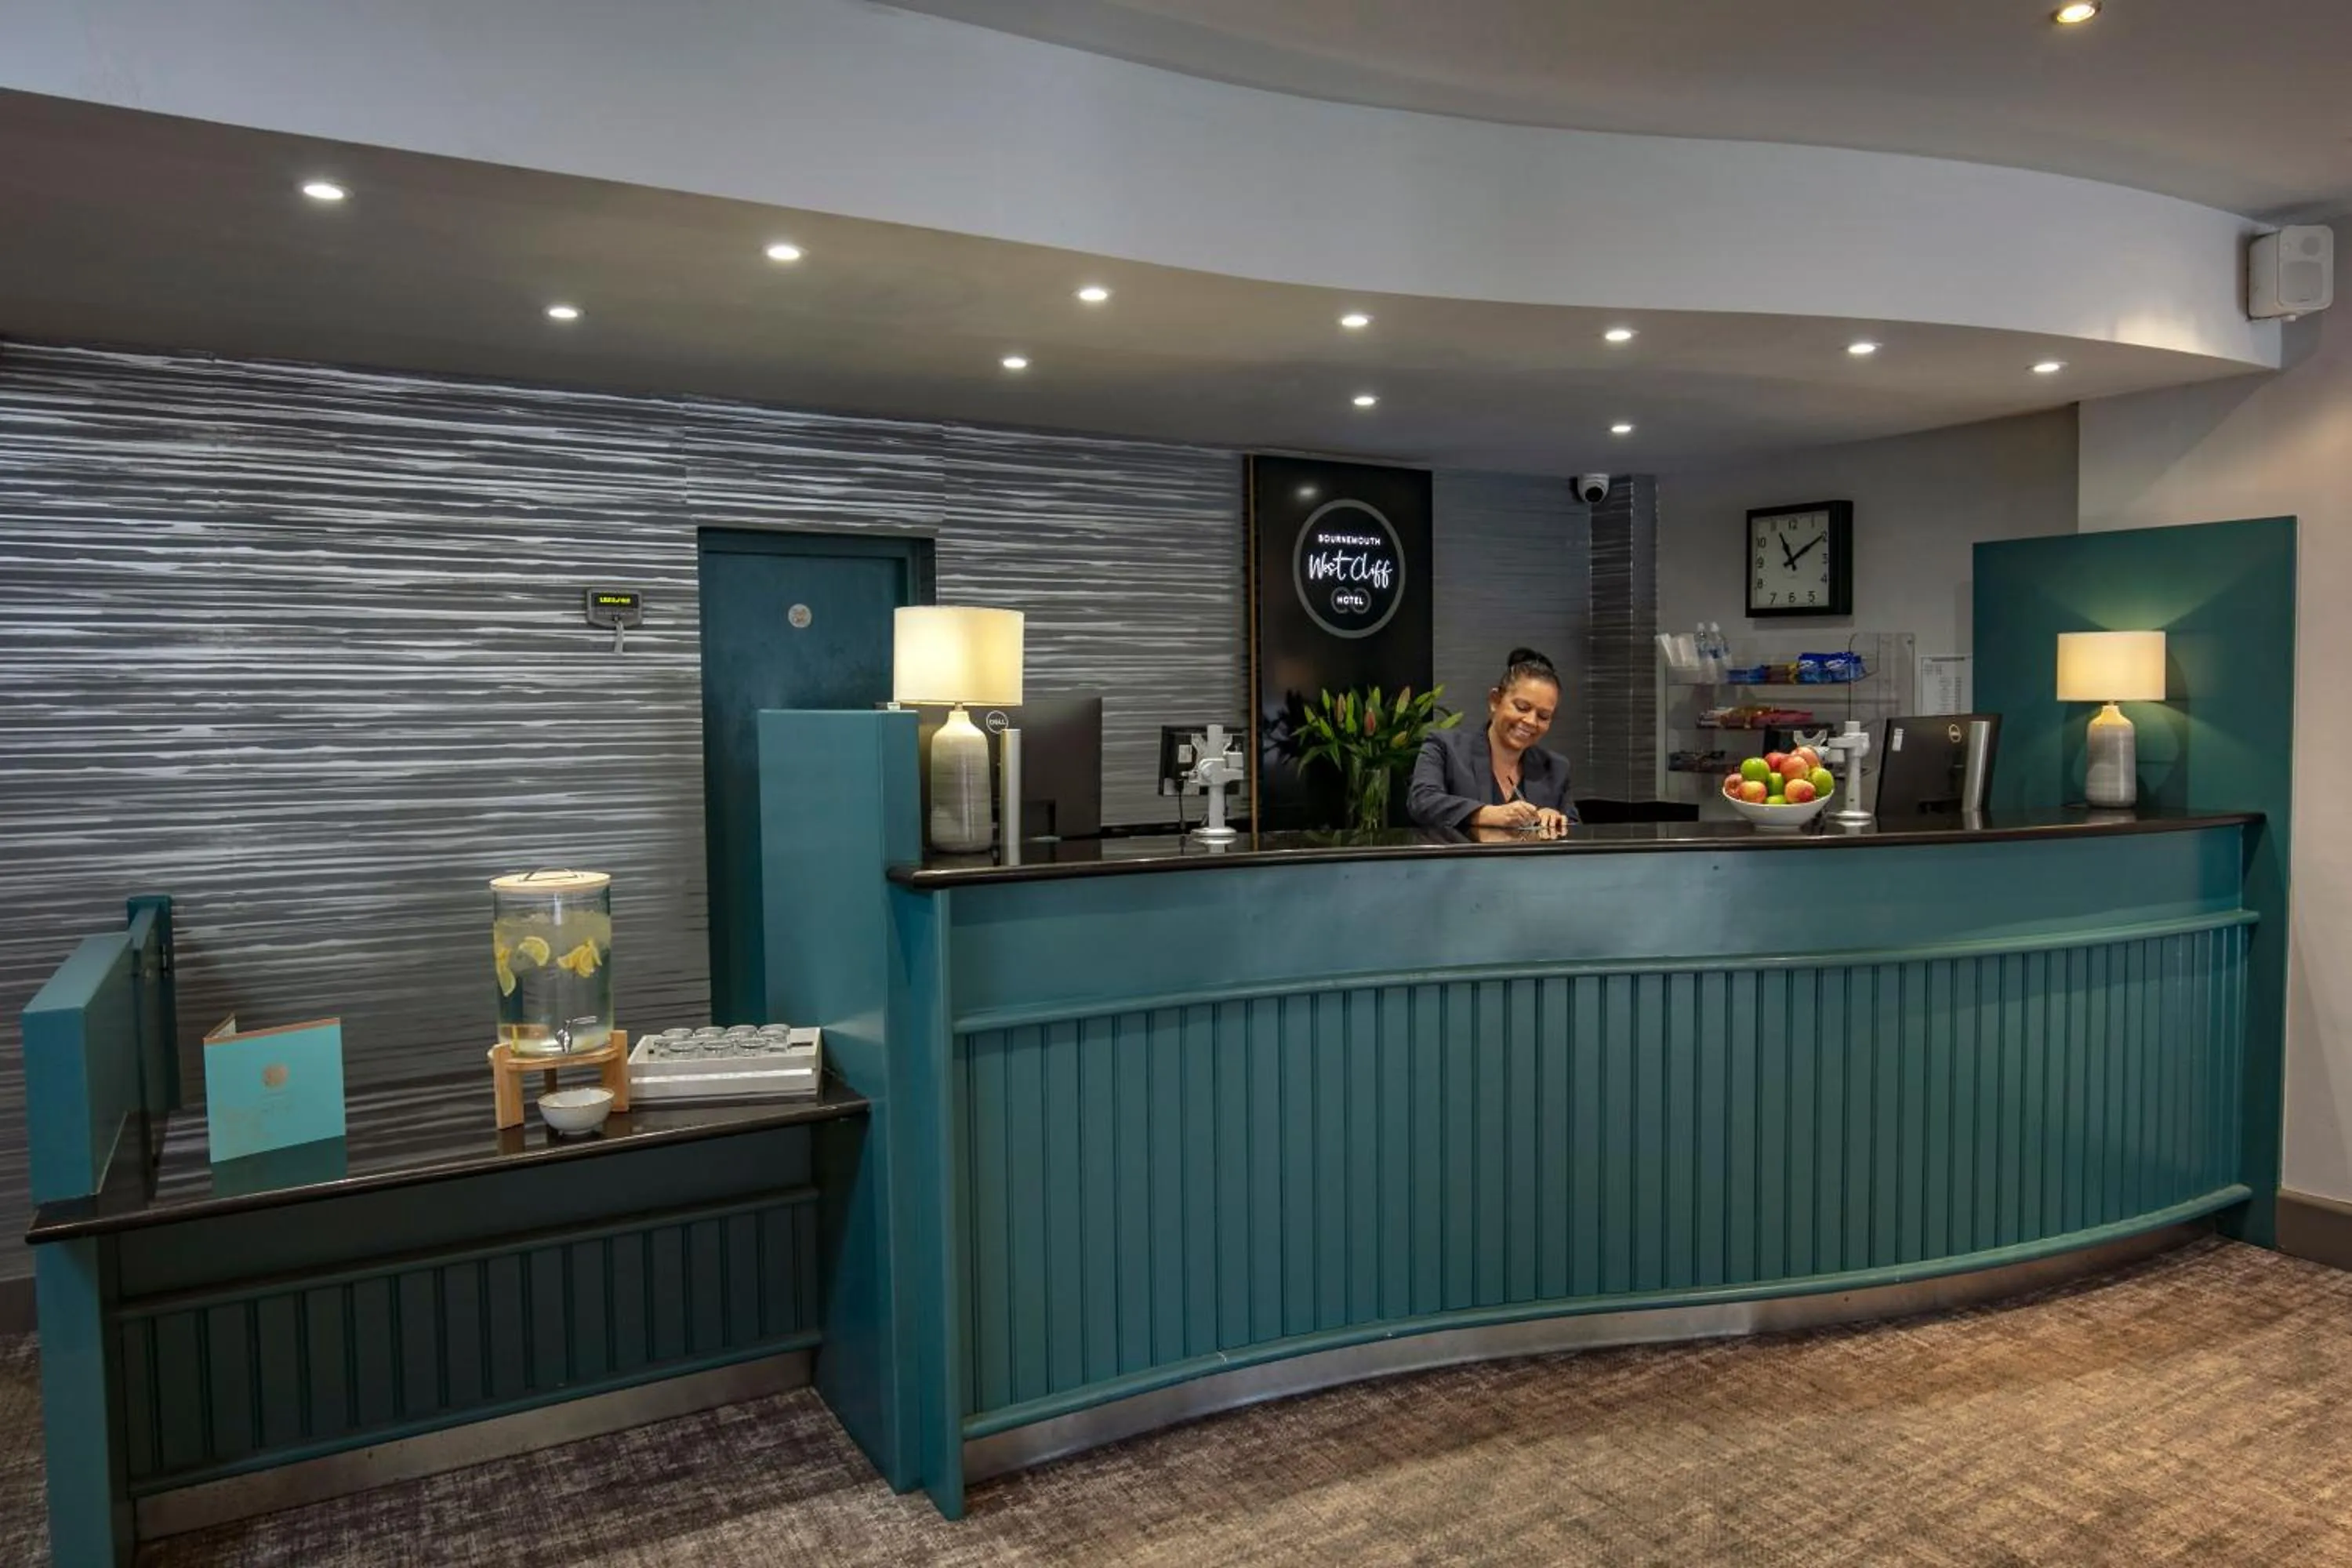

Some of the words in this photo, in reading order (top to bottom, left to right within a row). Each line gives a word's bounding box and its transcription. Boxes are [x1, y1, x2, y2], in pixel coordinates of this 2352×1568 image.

[1788, 519, 1798, 530] 12
[1318, 534, 1381, 546] BOURNEMOUTH
[1756, 536, 1766, 548] 10
[1756, 556, 1764, 568] 9
[1309, 550, 1353, 581] West
[1350, 552, 1392, 589] Cliff
[1757, 578, 1763, 589] 8
[1337, 596, 1363, 605] HOTEL
[1769, 593, 1777, 605] 7
[1788, 592, 1796, 604] 6
[1807, 590, 1816, 603] 5
